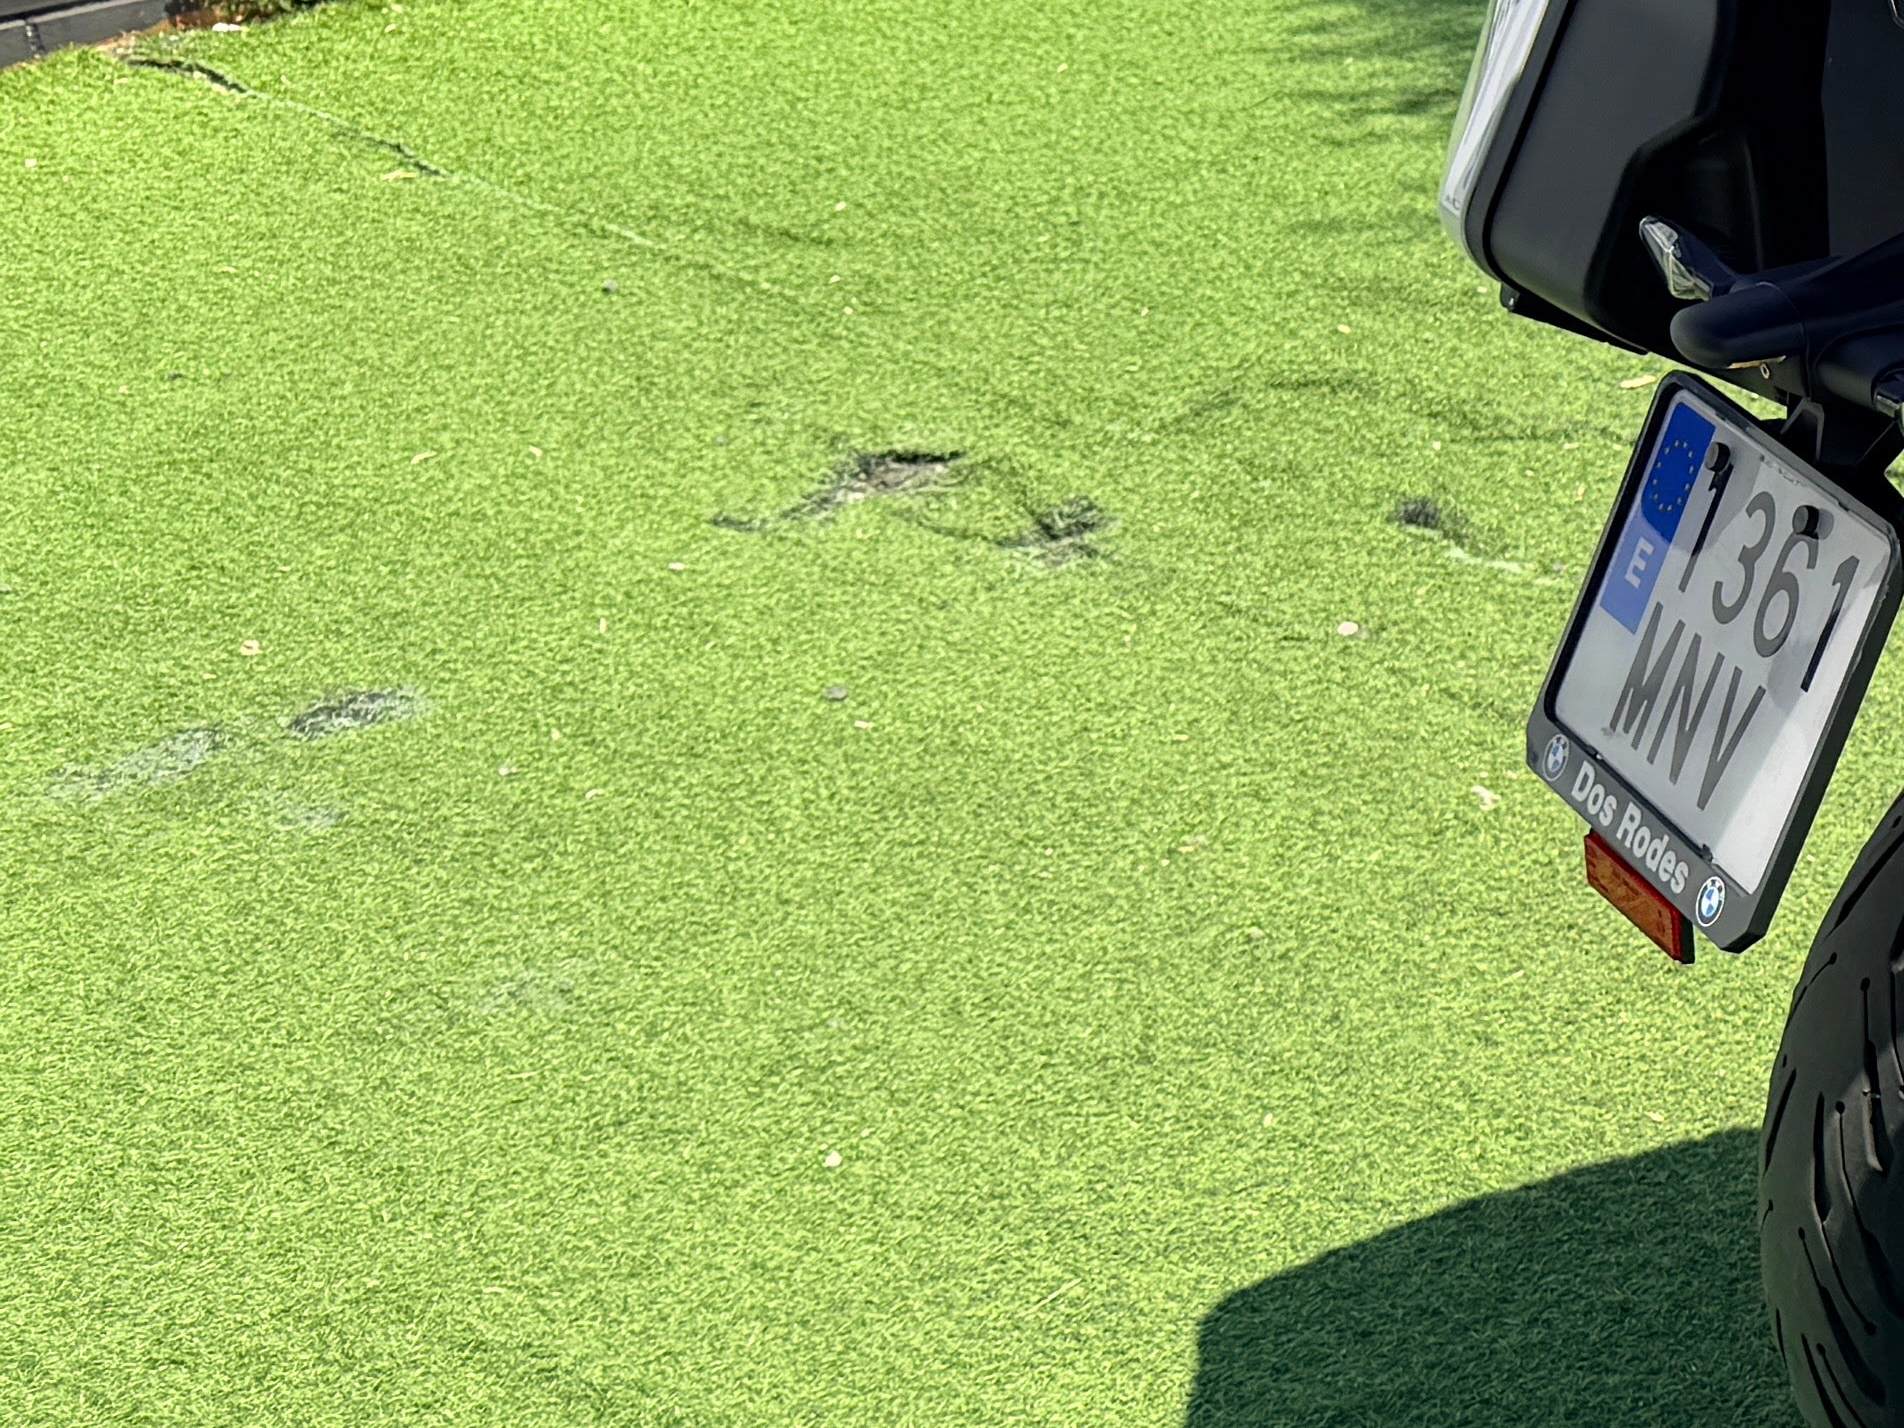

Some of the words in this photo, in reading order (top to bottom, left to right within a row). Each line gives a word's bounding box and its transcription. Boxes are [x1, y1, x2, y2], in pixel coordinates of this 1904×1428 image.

[1624, 536, 1655, 590] E
[1678, 460, 1861, 693] 1361
[1608, 601, 1767, 812] MNV
[1570, 759, 1618, 827] Dos
[1615, 801, 1690, 895] Rodes
